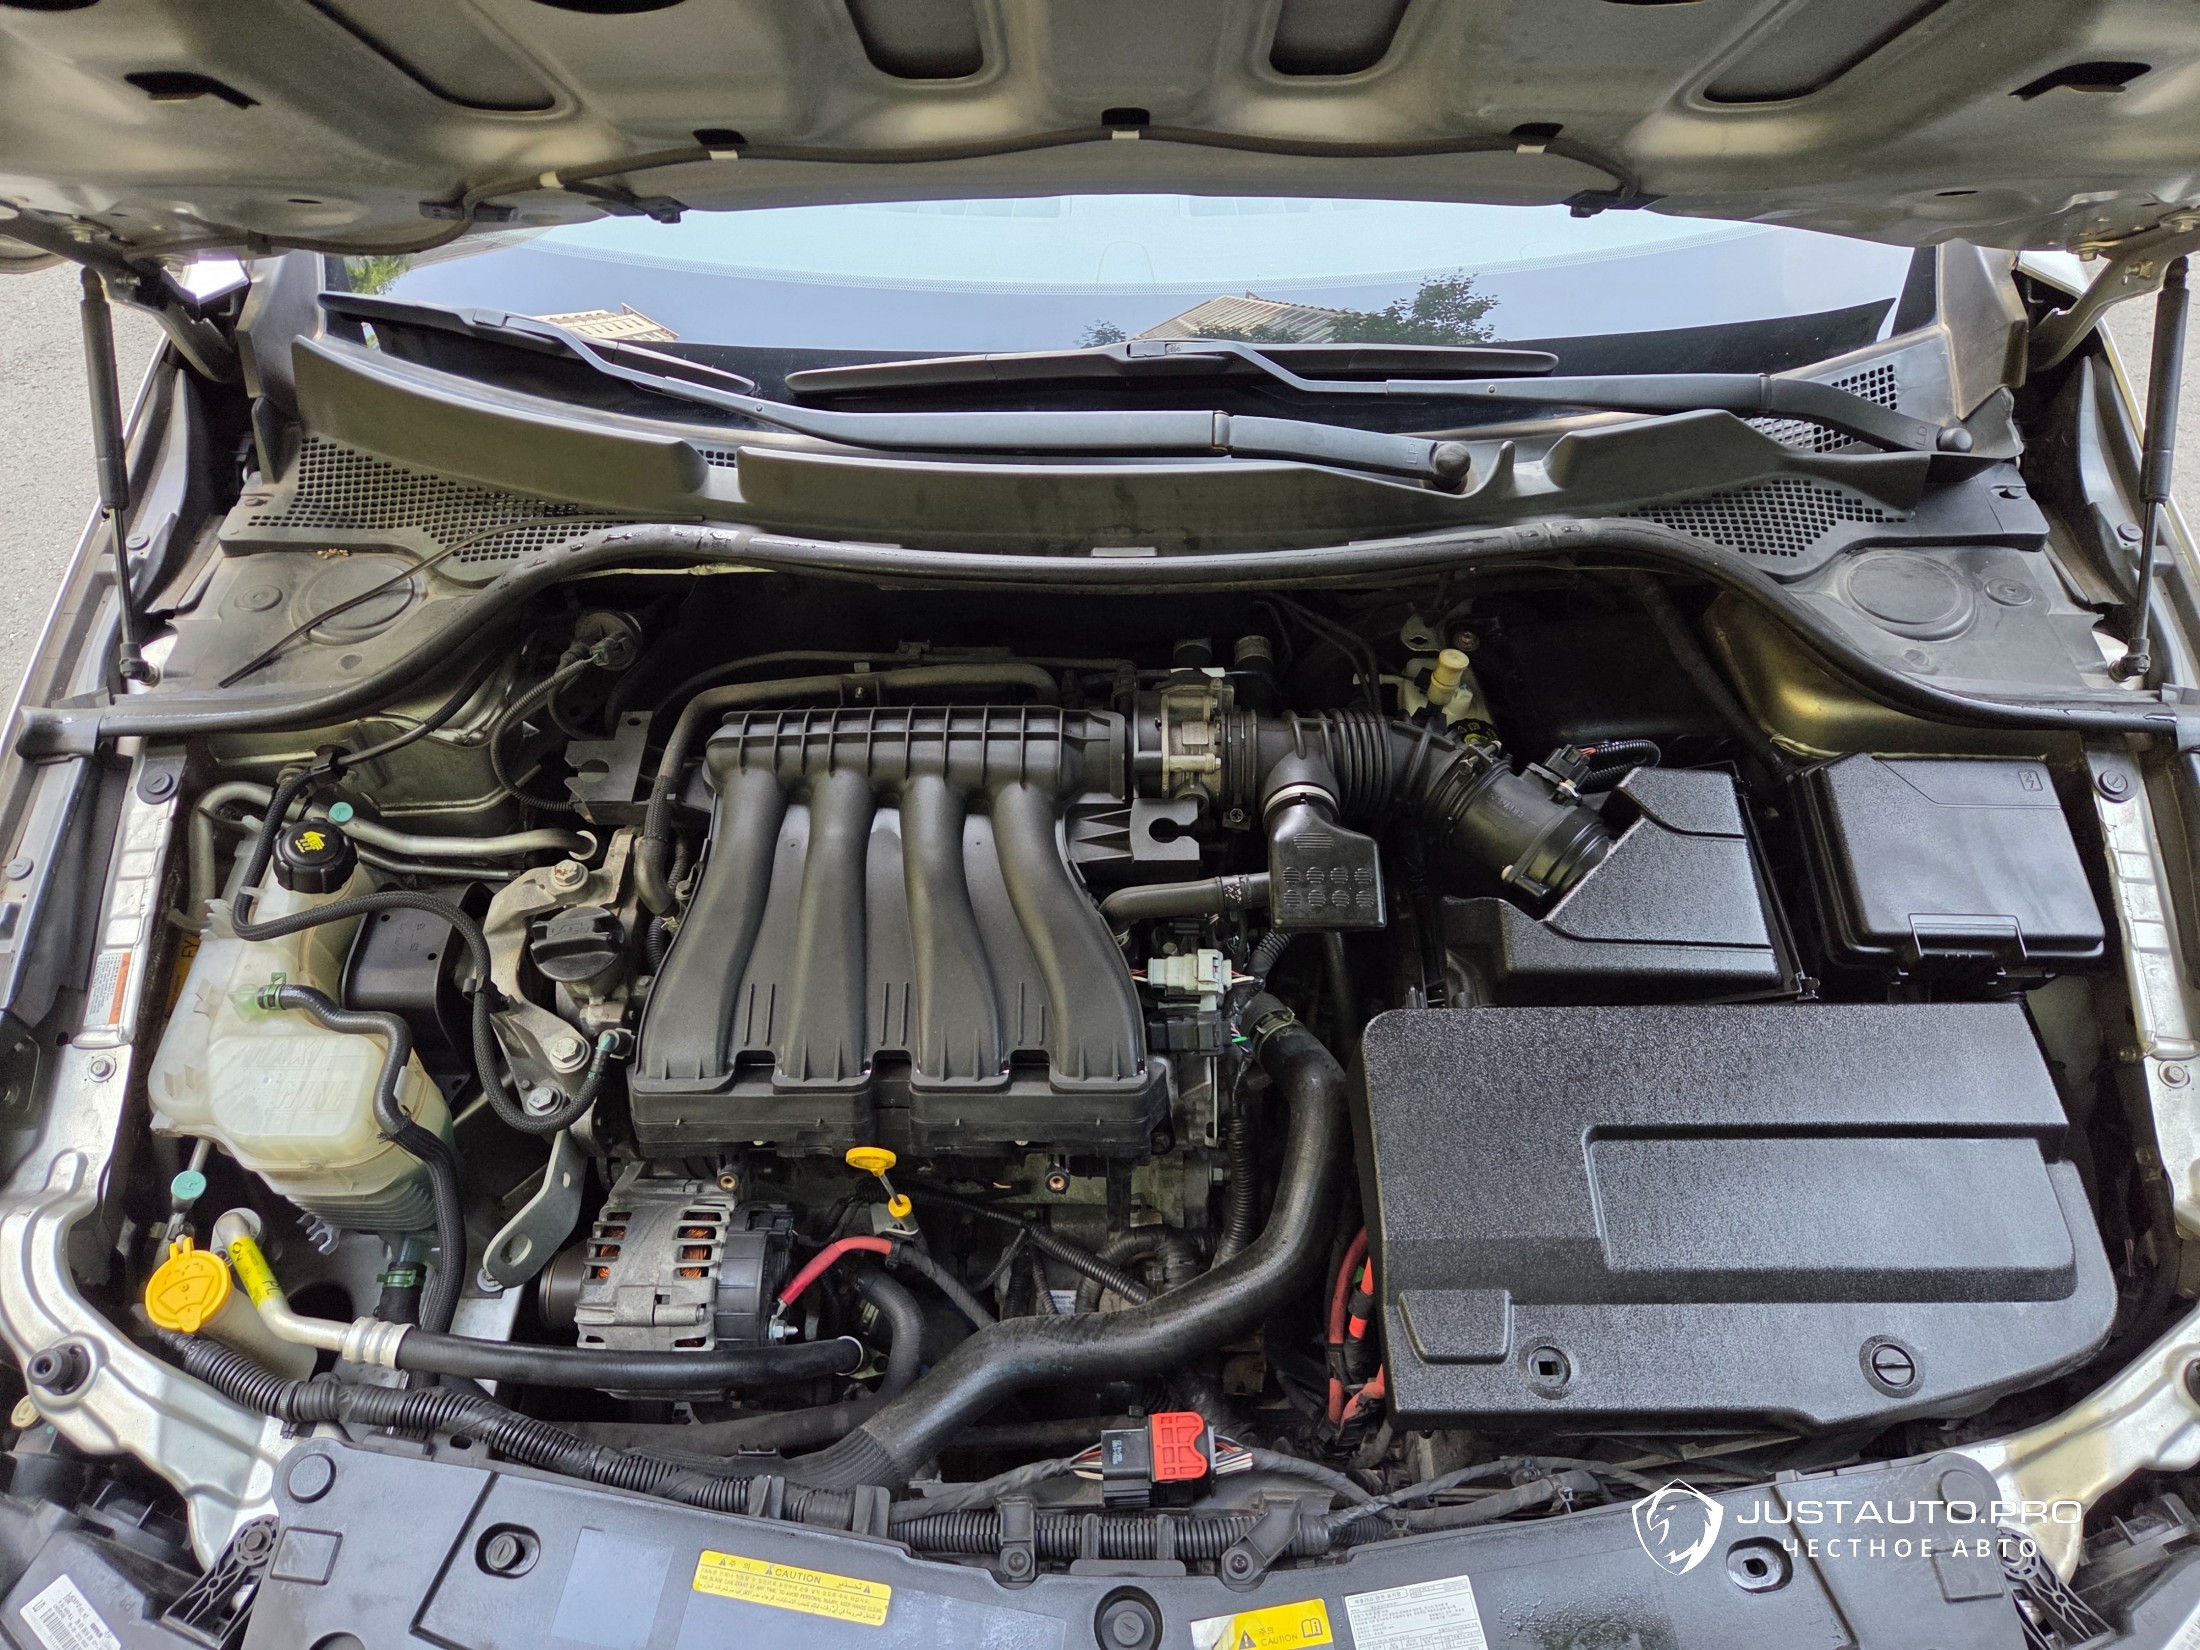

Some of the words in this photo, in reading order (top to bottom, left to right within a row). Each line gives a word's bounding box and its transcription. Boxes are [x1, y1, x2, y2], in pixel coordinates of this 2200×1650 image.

[774, 1568, 822, 1585] CAUTION
[1258, 1626, 1275, 1637] 주의
[1260, 1633, 1298, 1648] CAUTION
